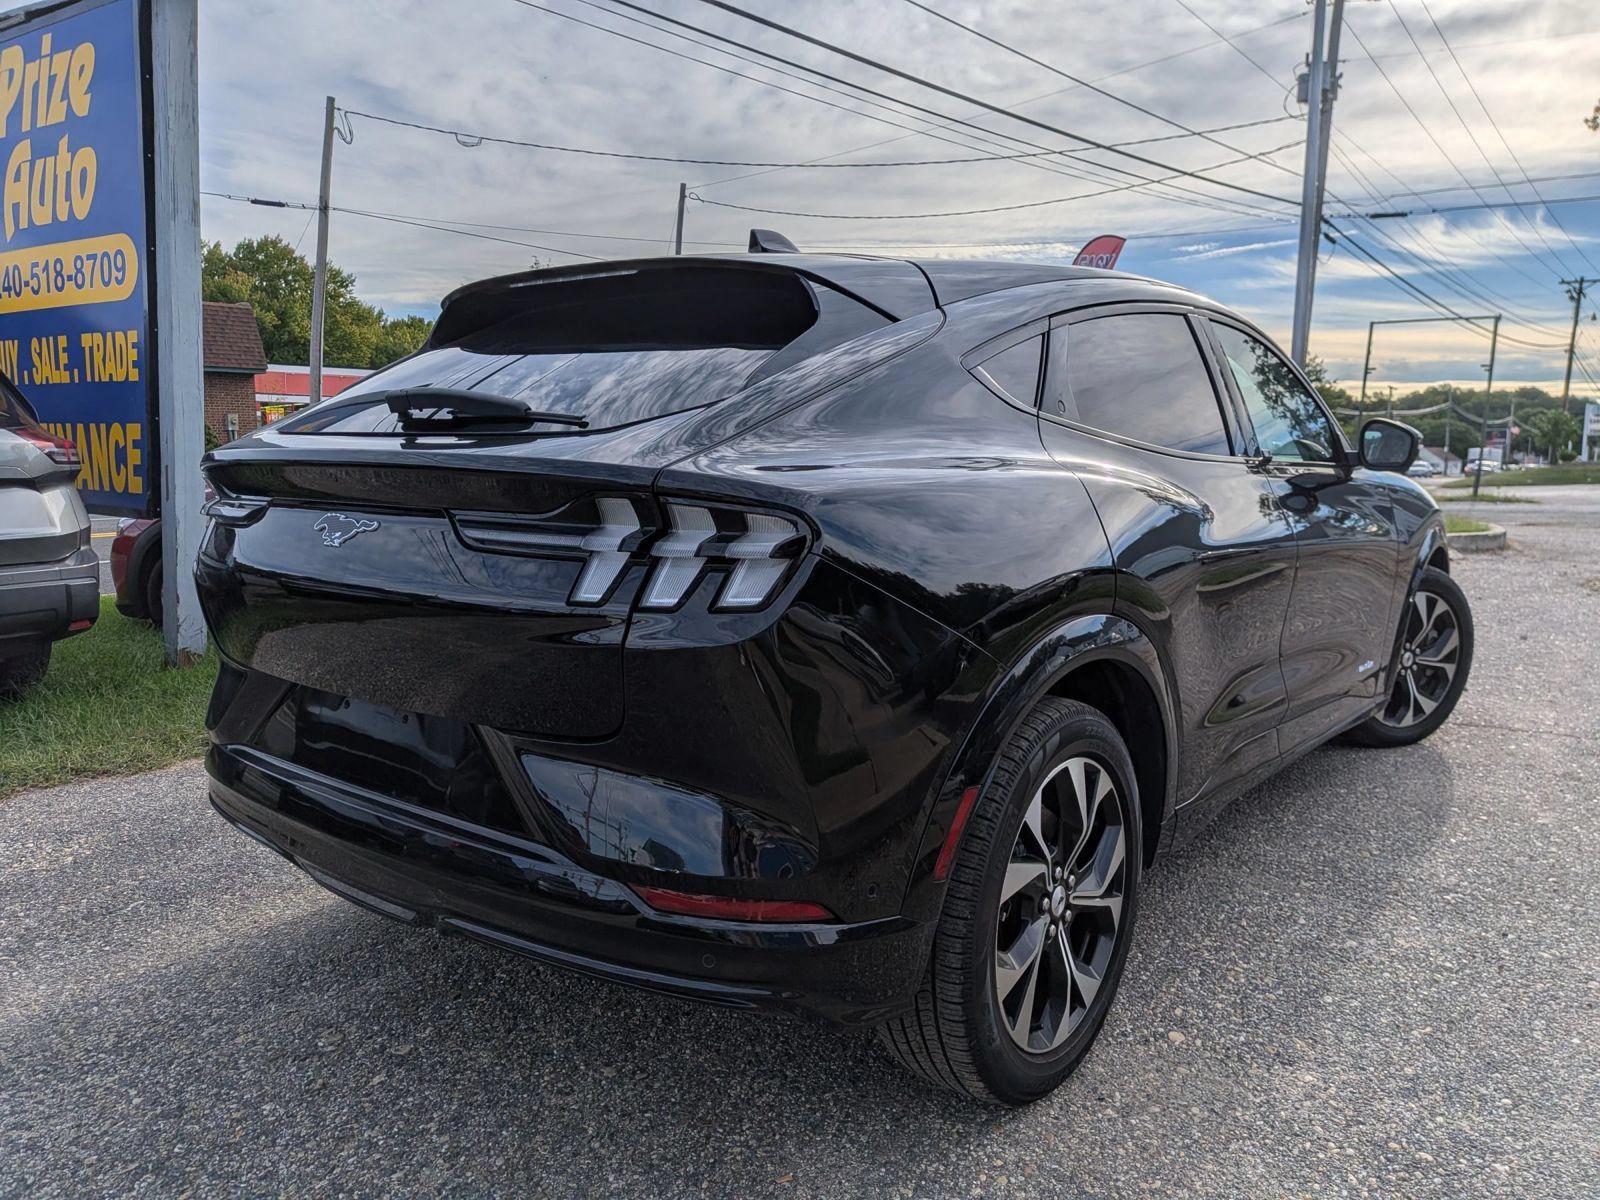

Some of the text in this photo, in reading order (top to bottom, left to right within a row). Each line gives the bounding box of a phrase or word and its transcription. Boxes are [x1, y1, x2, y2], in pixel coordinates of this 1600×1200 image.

[0, 32, 96, 139] Prize
[3, 132, 98, 244] Auto
[0, 248, 127, 299] 40-518-8709
[0, 339, 19, 386] UY
[30, 335, 71, 386] SALE
[80, 329, 140, 382] TRADE
[40, 422, 143, 494] ANCE
